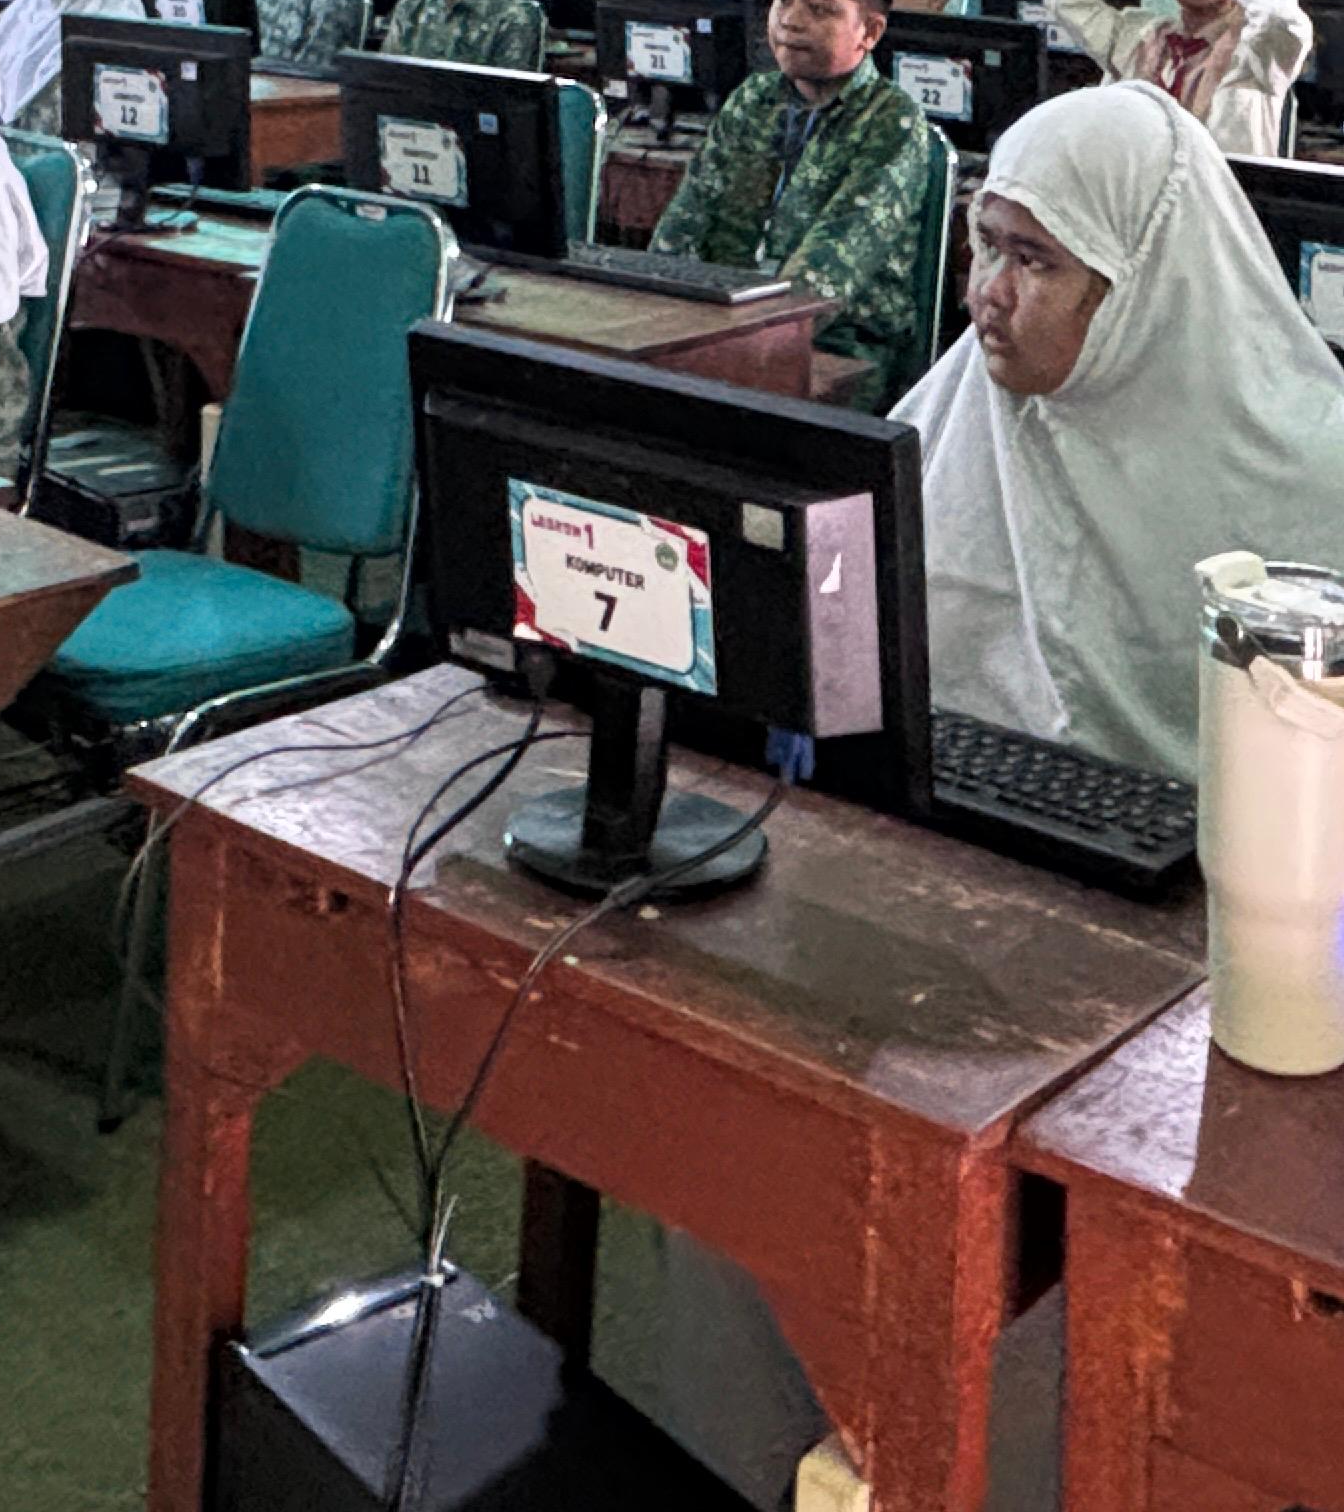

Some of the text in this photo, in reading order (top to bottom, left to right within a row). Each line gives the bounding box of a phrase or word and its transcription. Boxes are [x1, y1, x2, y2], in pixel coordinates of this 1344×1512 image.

[413, 164, 431, 185] 11
[584, 524, 594, 550] 1
[565, 553, 645, 590] KOMPUTER
[594, 590, 617, 632] 7
